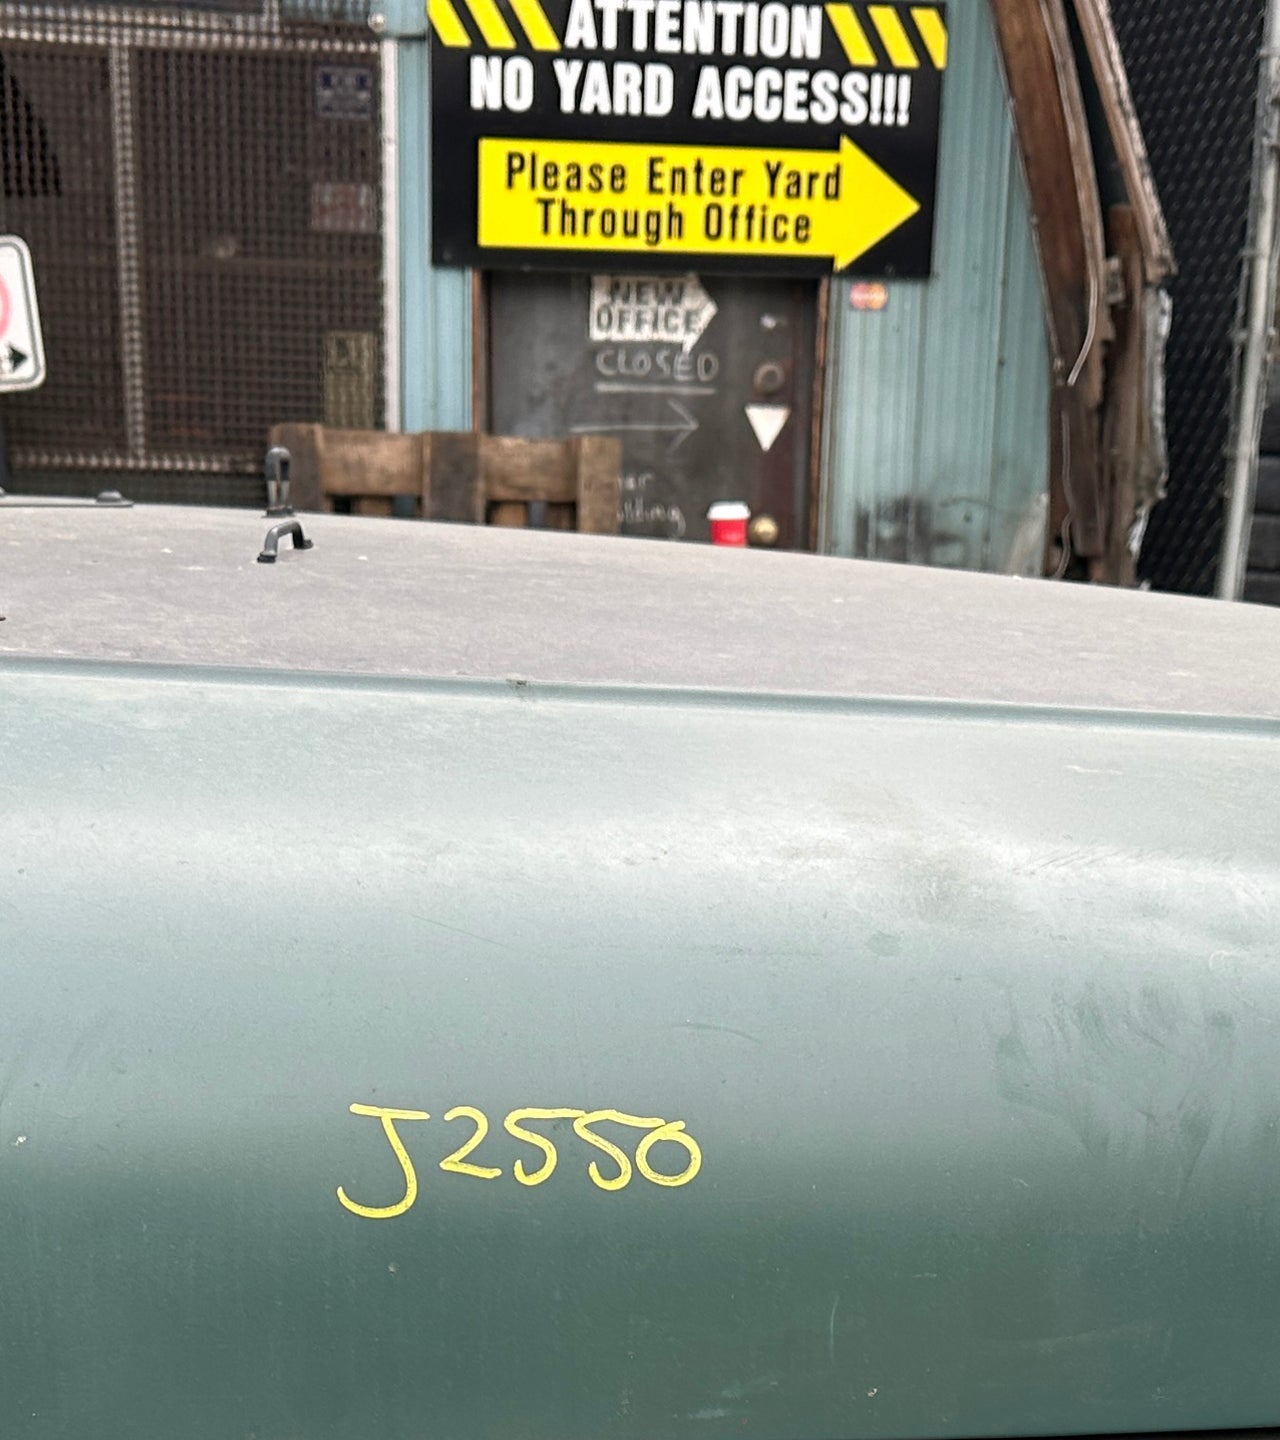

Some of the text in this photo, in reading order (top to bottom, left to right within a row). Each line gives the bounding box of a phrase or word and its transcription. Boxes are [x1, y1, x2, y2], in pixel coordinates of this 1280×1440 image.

[563, 0, 822, 60] ATTENTION
[470, 55, 912, 127] NO YARD ACCESS!!!
[506, 151, 842, 201] Please Enter Yard
[537, 196, 813, 246] Through Office
[596, 347, 719, 382] CLOSED
[336, 1102, 703, 1220] J2550
